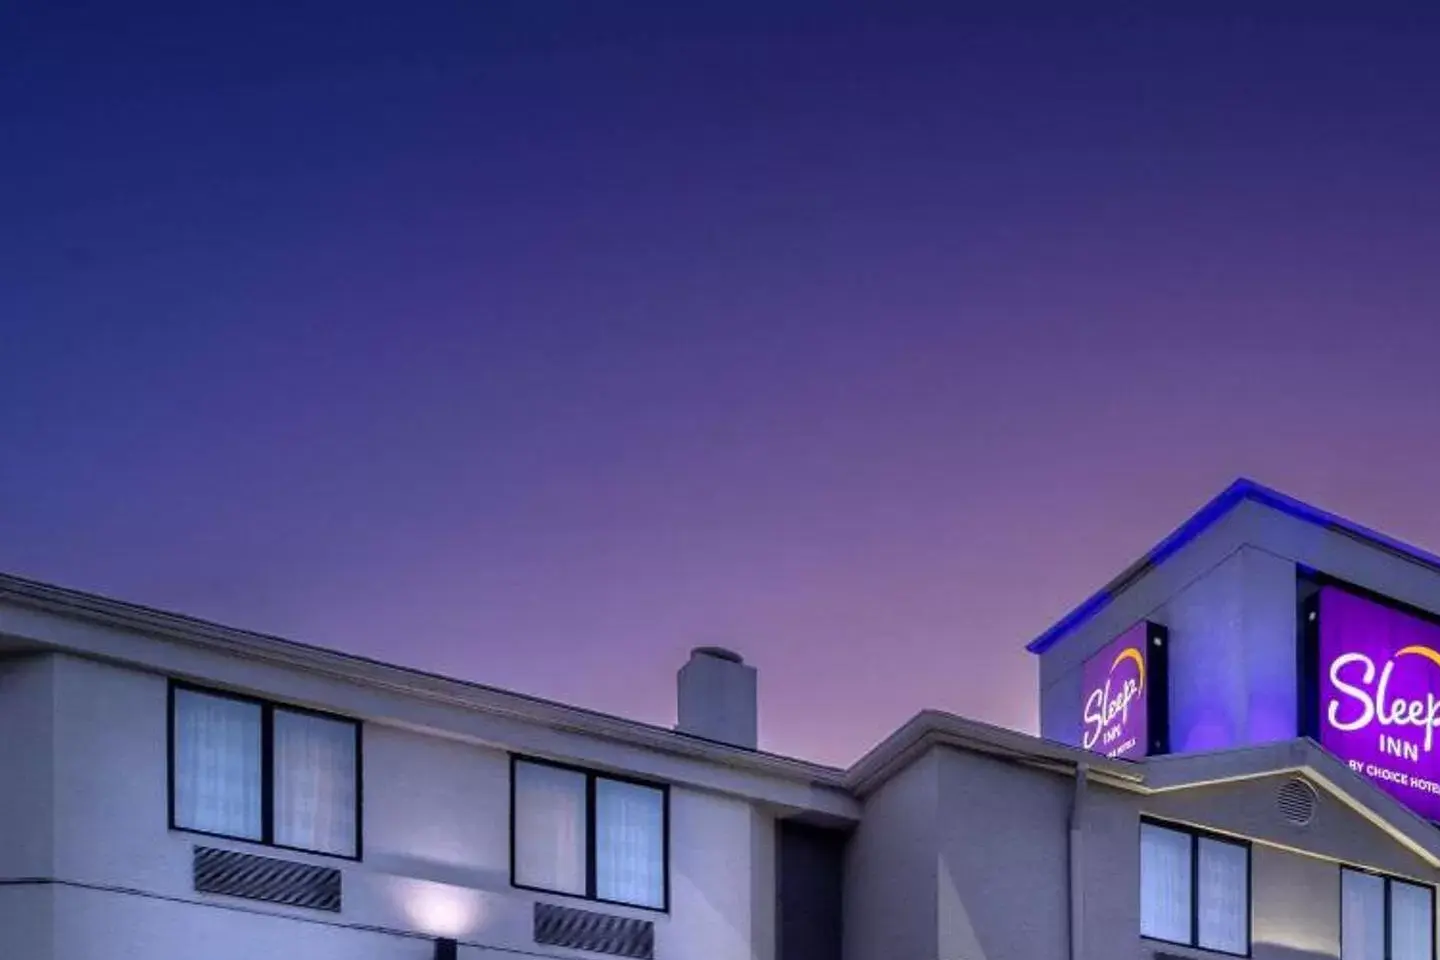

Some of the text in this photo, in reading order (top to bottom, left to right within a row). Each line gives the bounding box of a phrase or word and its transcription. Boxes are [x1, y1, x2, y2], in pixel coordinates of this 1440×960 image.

[1083, 679, 1138, 749] Sleep
[1379, 733, 1419, 762] INN
[1348, 759, 1365, 773] BY
[1366, 764, 1409, 786] CHOICE
